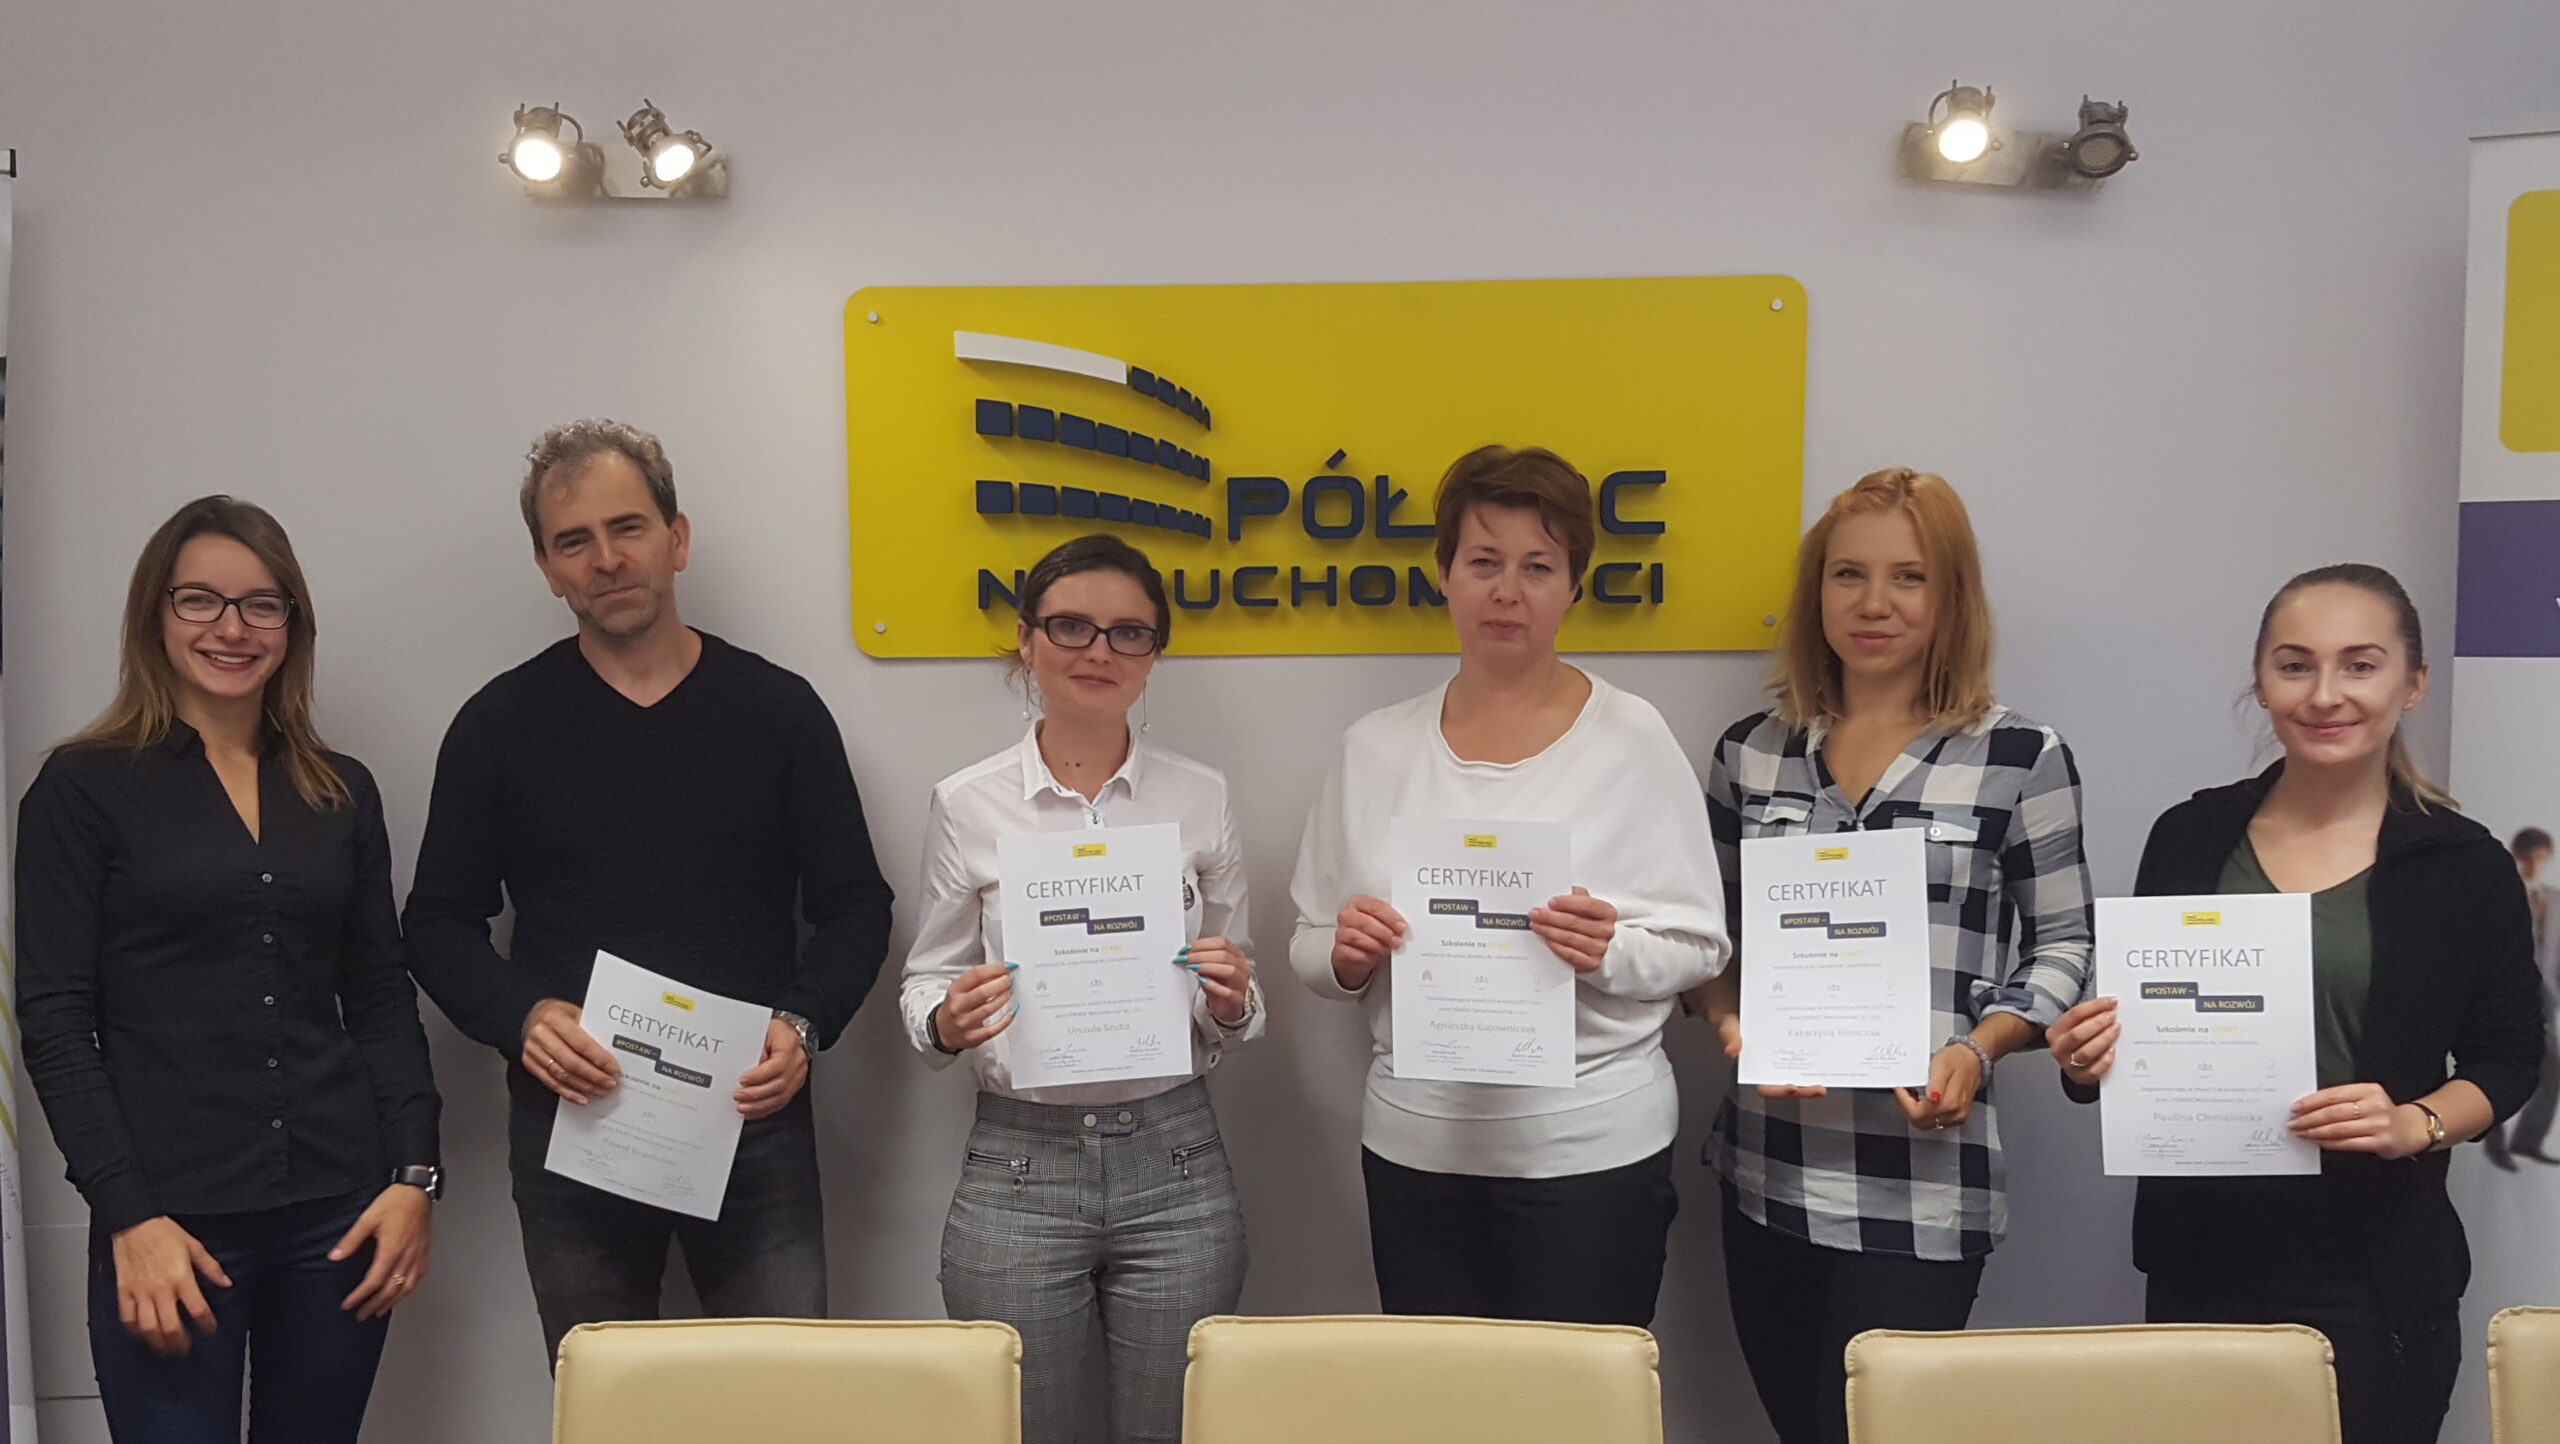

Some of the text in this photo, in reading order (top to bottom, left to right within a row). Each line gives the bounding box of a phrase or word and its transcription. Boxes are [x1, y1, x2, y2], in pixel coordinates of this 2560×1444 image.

[1226, 448, 1667, 541] PÓŁC
[1026, 874, 1144, 899] CERTYFIKAT
[1417, 867, 1534, 888] CERTYFIKAT
[1767, 879, 1887, 901] CERTYFIKAT
[1432, 903, 1469, 911] #POSTAW
[1094, 923, 1105, 931] NA
[2126, 948, 2266, 968] CERTYFIKAT
[2145, 987, 2188, 995] #POSTAW
[2203, 1000, 2217, 1008] NA
[608, 1004, 724, 1054] CERTYFIKAT
